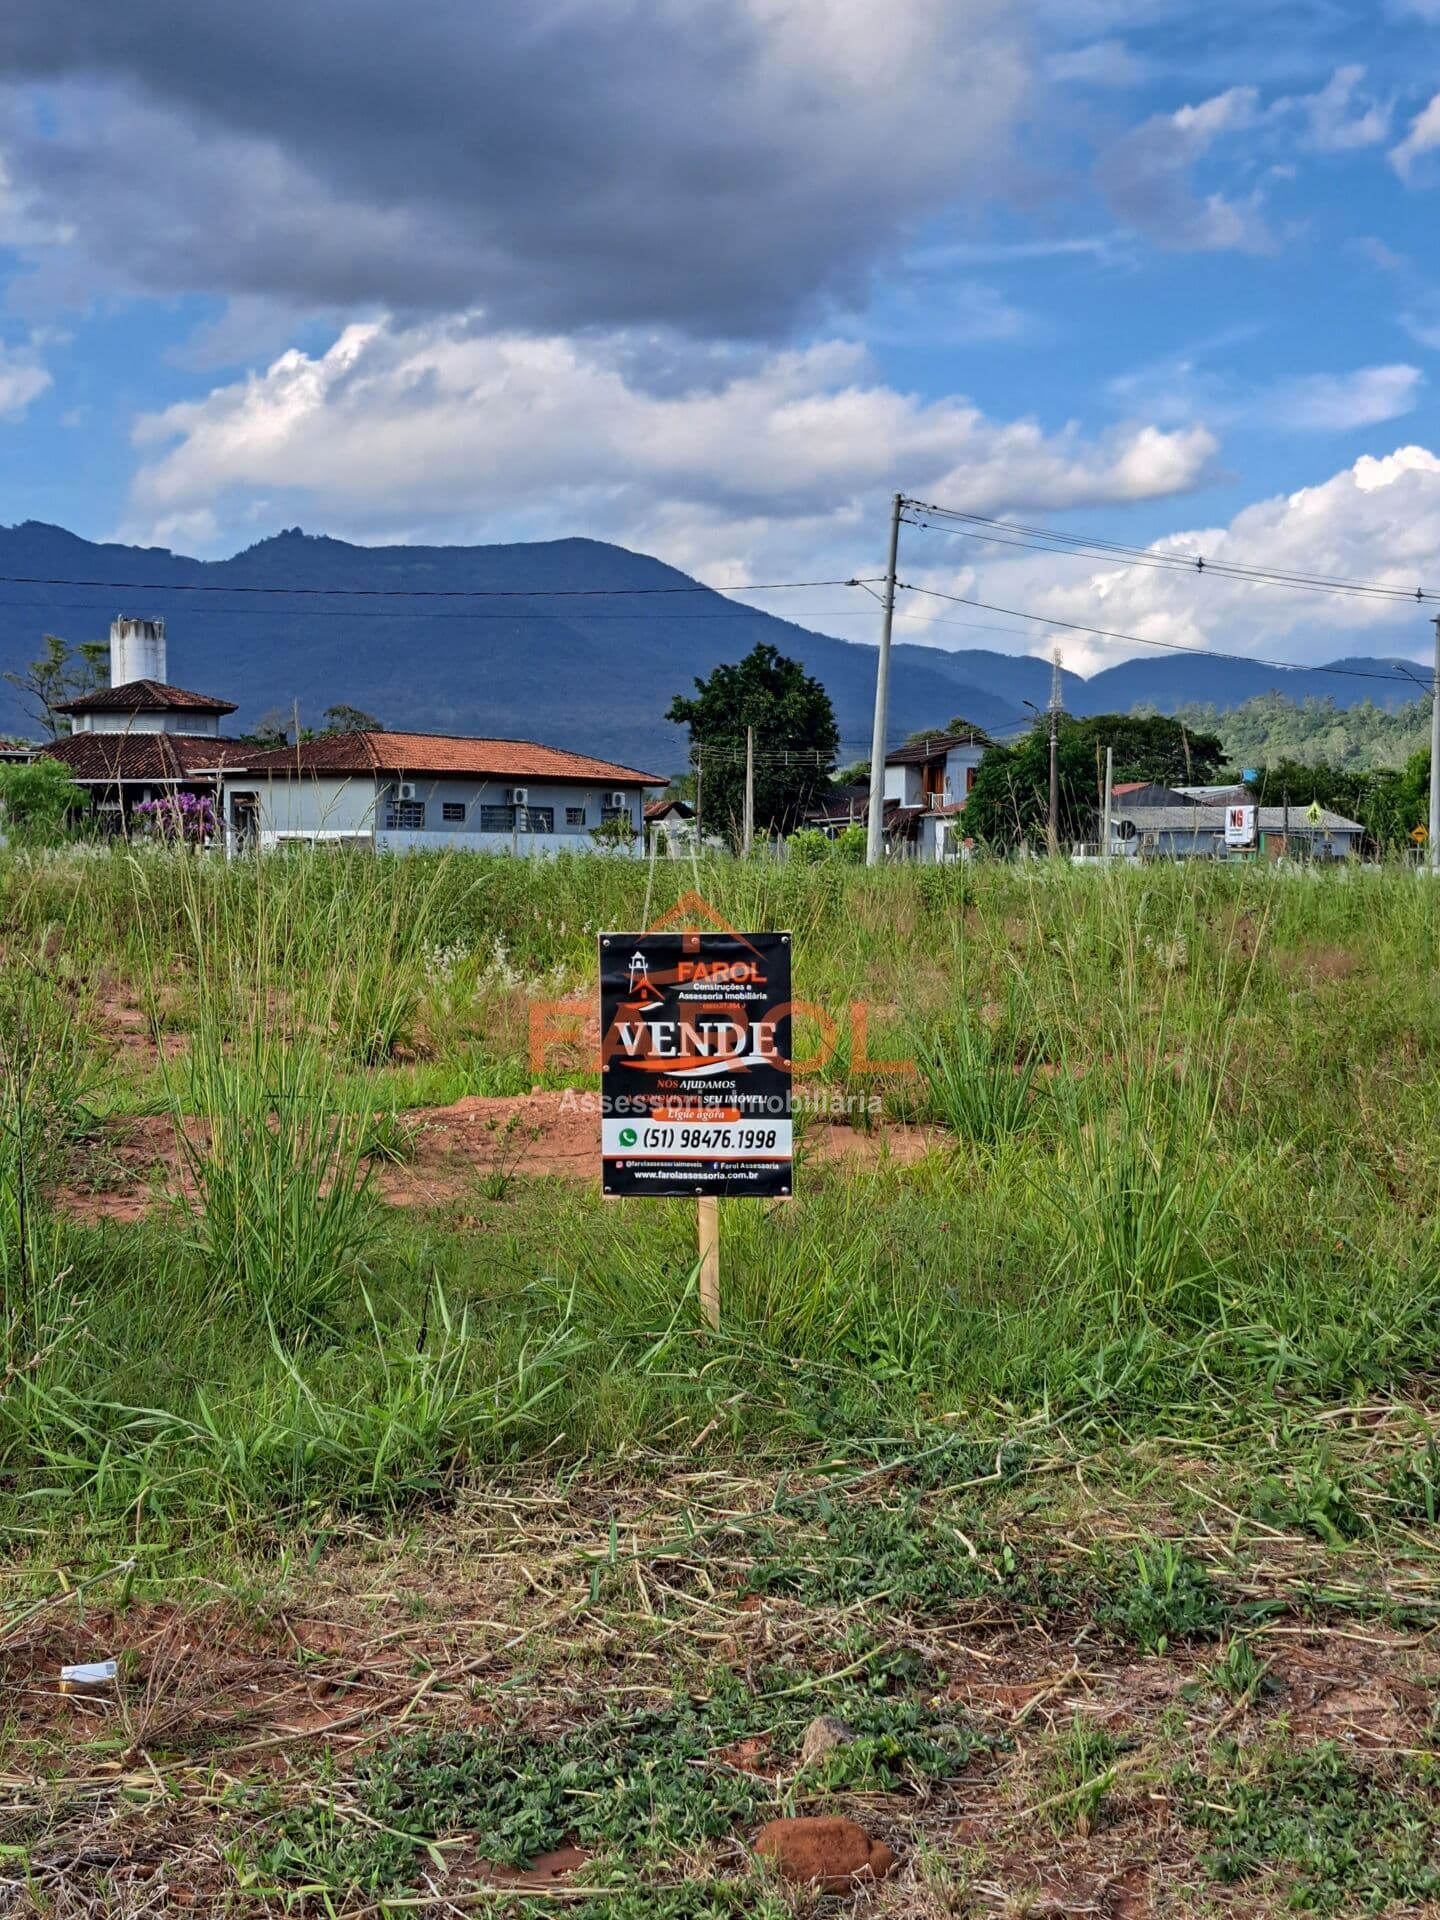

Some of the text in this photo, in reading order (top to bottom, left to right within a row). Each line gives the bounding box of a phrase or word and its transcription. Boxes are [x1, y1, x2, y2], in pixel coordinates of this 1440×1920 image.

[677, 961, 768, 983] FAROL
[693, 983, 745, 992] Construções
[678, 992, 768, 1000] Assessoria Imobiliária
[614, 1022, 778, 1056] VENDE
[657, 1079, 736, 1089] NÓS AJUDAMOS
[703, 1095, 723, 1104] SEU
[725, 1093, 768, 1104] IMÓVEL!
[667, 1109, 725, 1121] Ligue agora
[643, 1128, 777, 1149] (51) 98476.1998
[720, 1162, 779, 1170] Farol Assessoria
[634, 1170, 759, 1180] www.farolassessoria.com.br
